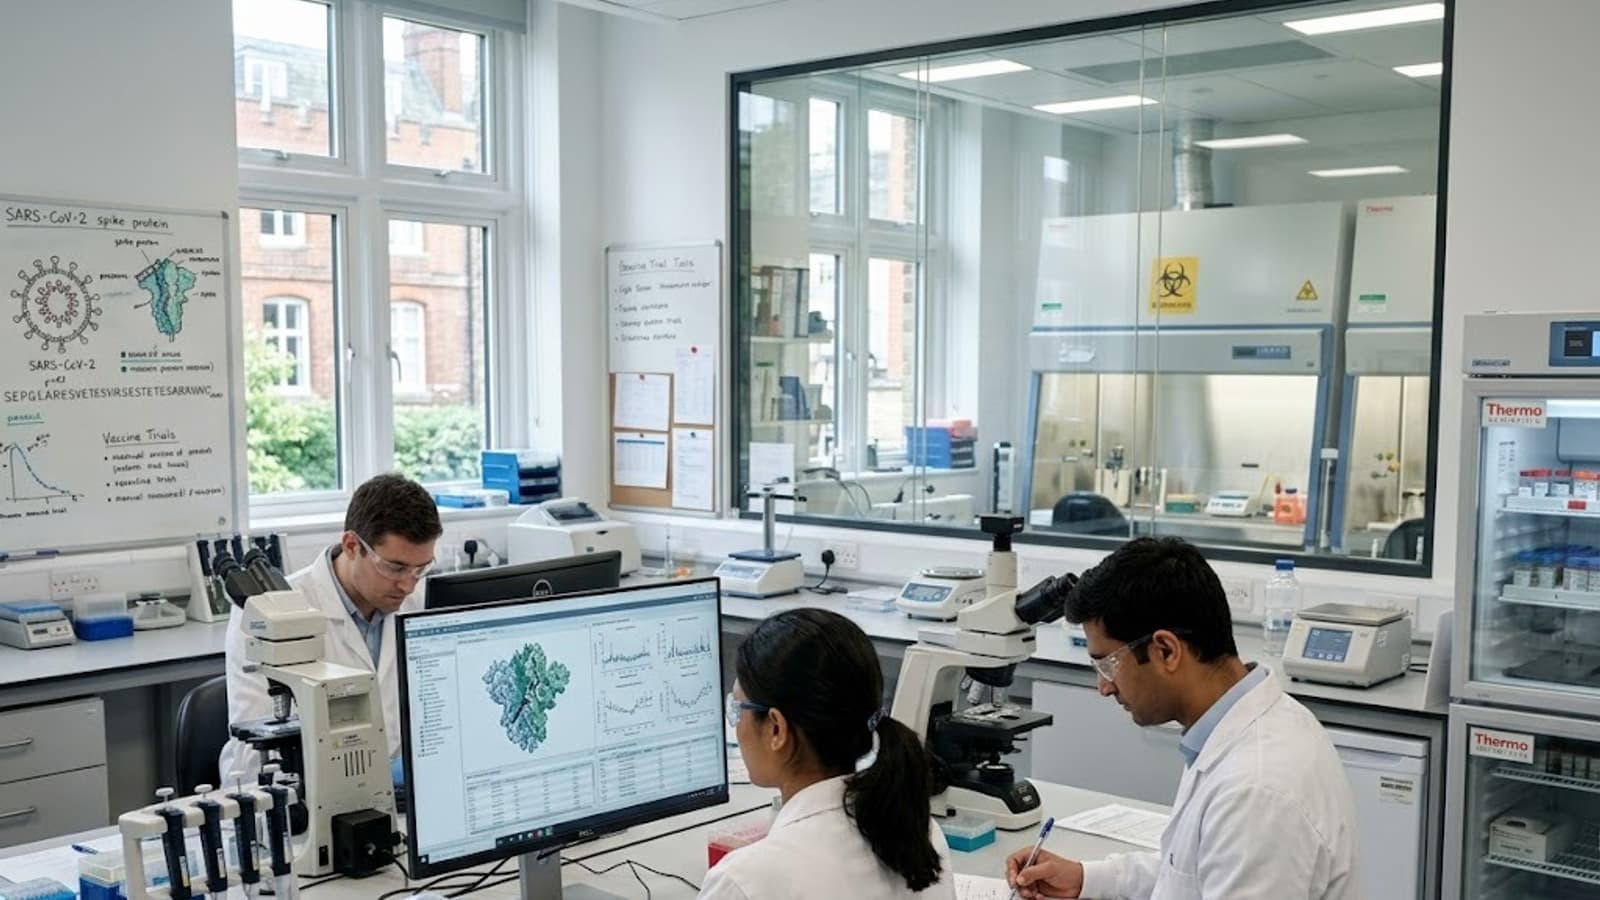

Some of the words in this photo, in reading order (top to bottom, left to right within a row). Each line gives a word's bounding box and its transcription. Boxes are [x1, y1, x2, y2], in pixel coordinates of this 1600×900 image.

[97, 216, 125, 228] spike
[132, 217, 169, 229] protein
[1487, 403, 1543, 417] Thermo
[102, 431, 141, 444] Vaccine
[1474, 732, 1529, 751] Thermo
